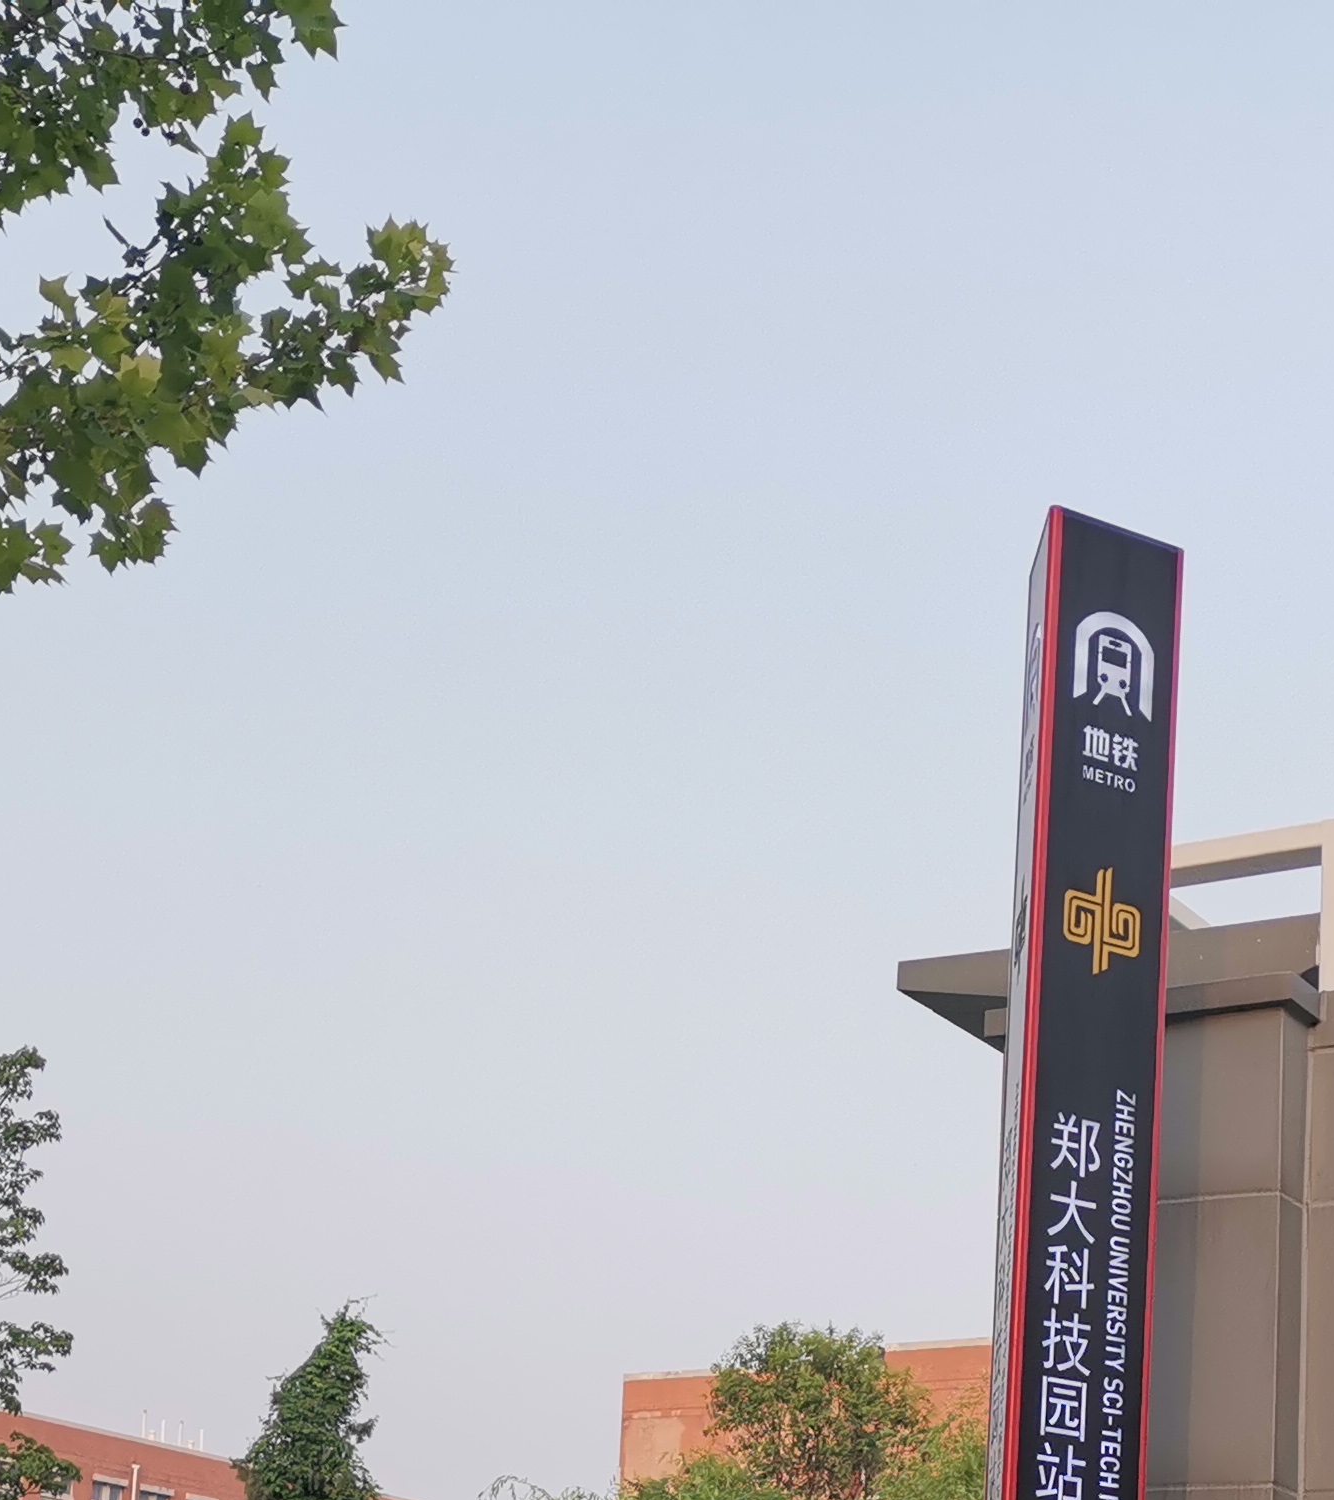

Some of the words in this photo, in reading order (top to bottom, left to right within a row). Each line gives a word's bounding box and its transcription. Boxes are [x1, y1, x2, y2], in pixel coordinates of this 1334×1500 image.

[1081, 724, 1140, 772] 地铁
[1081, 764, 1136, 793] METRO
[1111, 1088, 1137, 1232] ZHENGZHOU
[1103, 1235, 1132, 1374] UNIVERSITY
[1099, 1378, 1125, 1491] SCI-TECH
